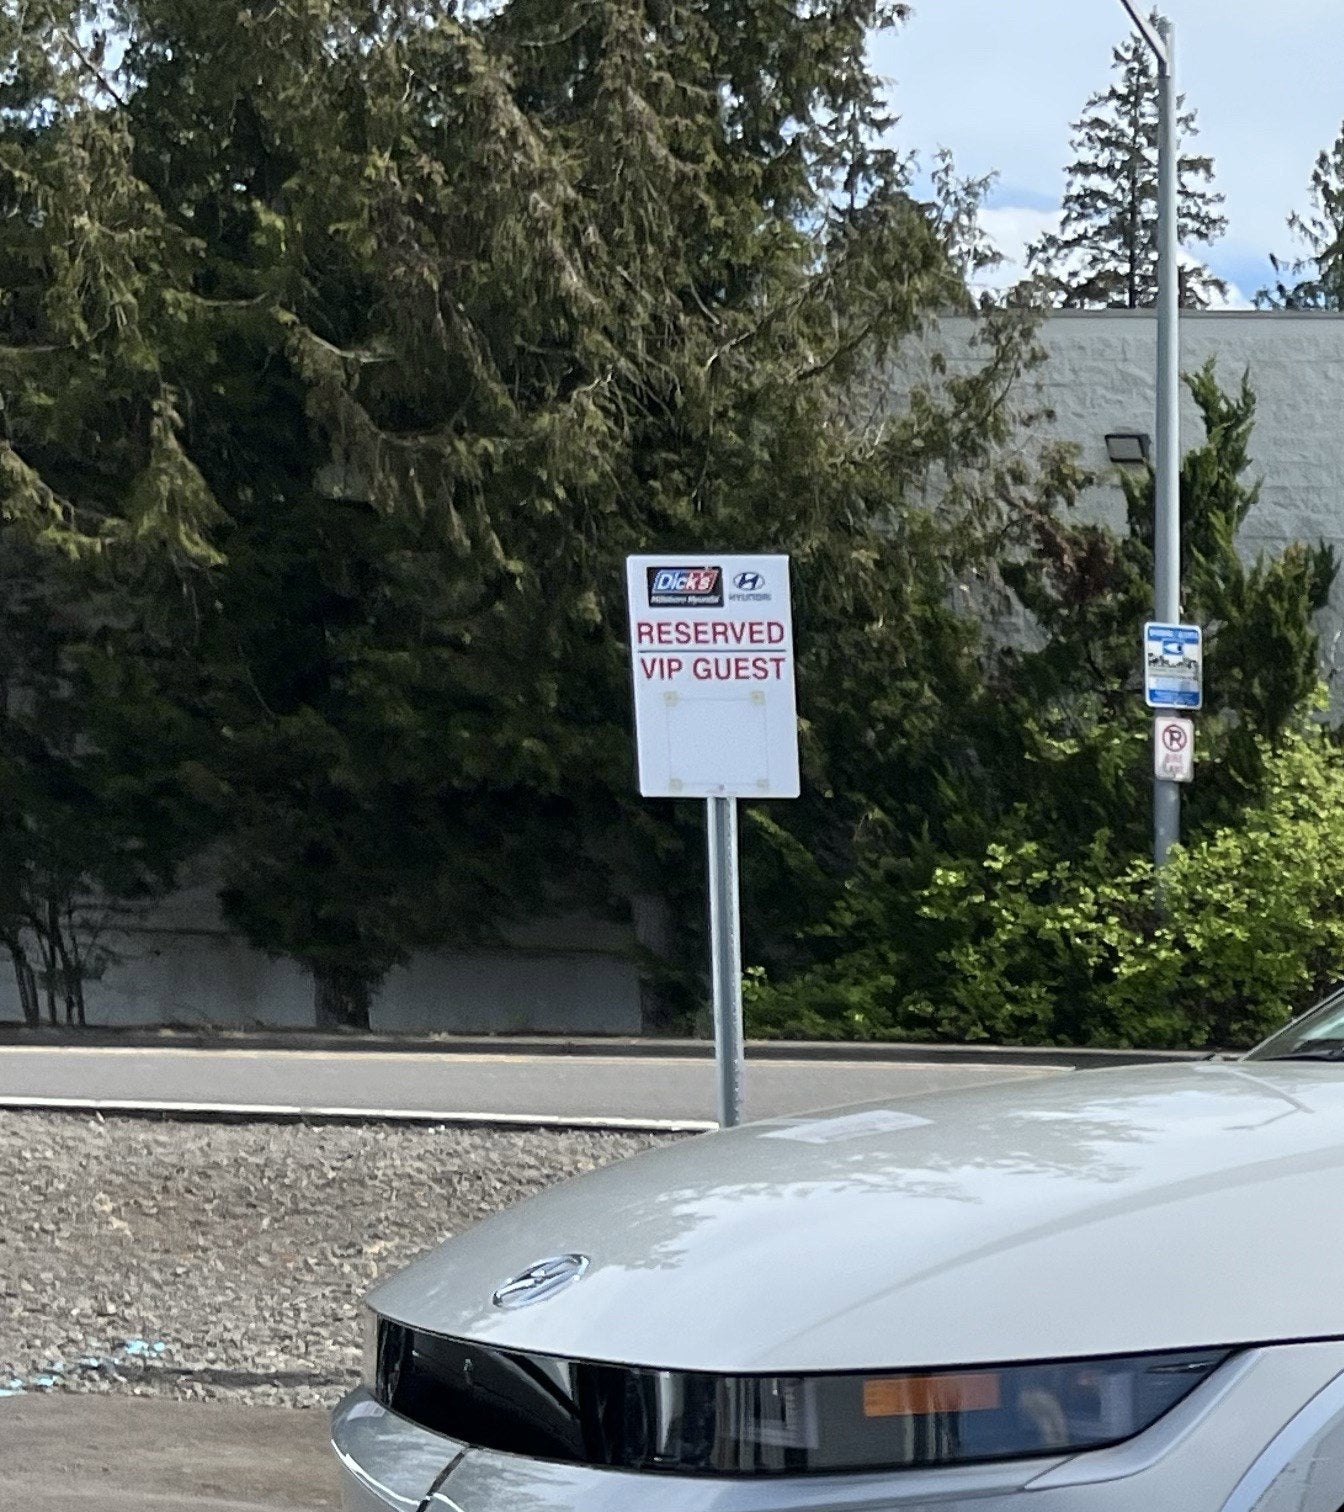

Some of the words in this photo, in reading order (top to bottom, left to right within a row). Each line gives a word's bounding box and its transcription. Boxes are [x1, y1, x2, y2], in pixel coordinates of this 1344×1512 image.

[636, 621, 785, 644] RESERVED
[640, 657, 683, 681] VIP
[692, 657, 786, 681] GUEST
